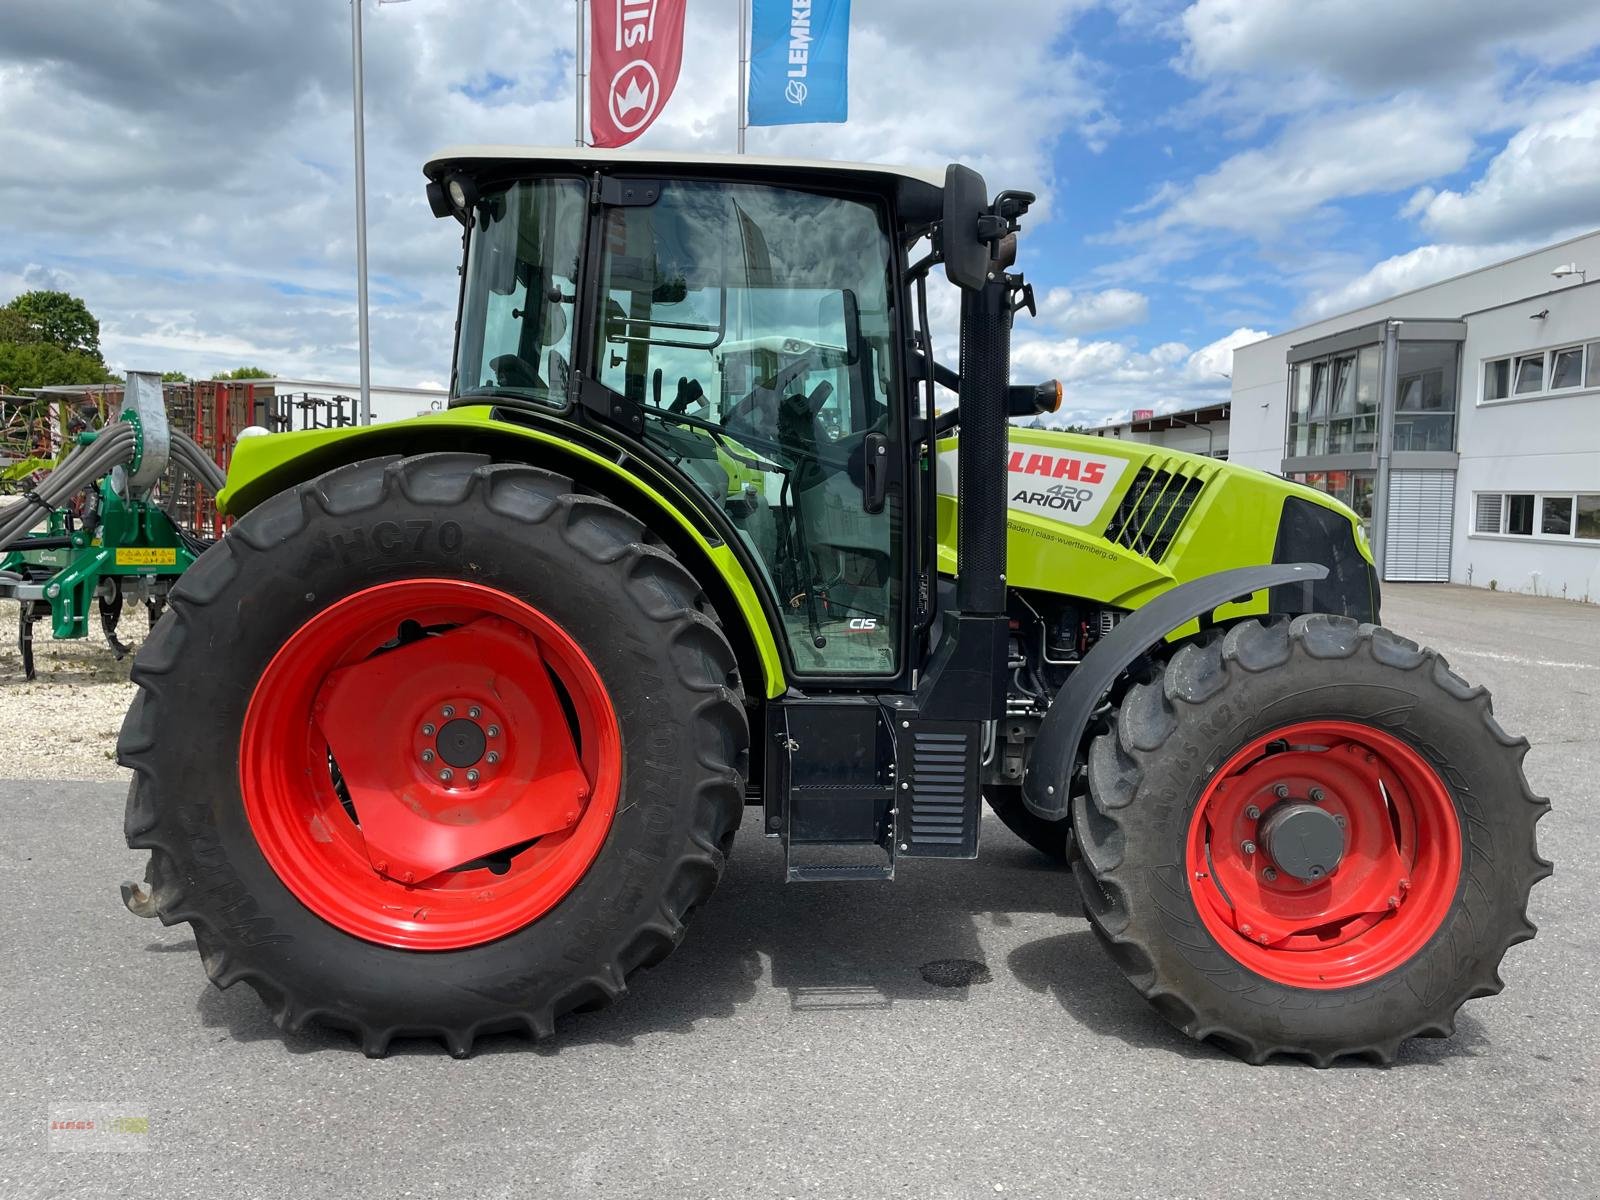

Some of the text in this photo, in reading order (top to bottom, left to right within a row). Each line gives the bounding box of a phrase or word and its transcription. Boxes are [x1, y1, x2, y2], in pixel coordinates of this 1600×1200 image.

[623, 0, 650, 48] SI
[1008, 451, 1107, 485] LAAS
[1012, 490, 1082, 513] ARION
[1046, 484, 1093, 502] 420
[1007, 521, 1030, 534] Baden
[1036, 532, 1118, 562] claas-wuerttemberg.de
[850, 619, 876, 629] CIS
